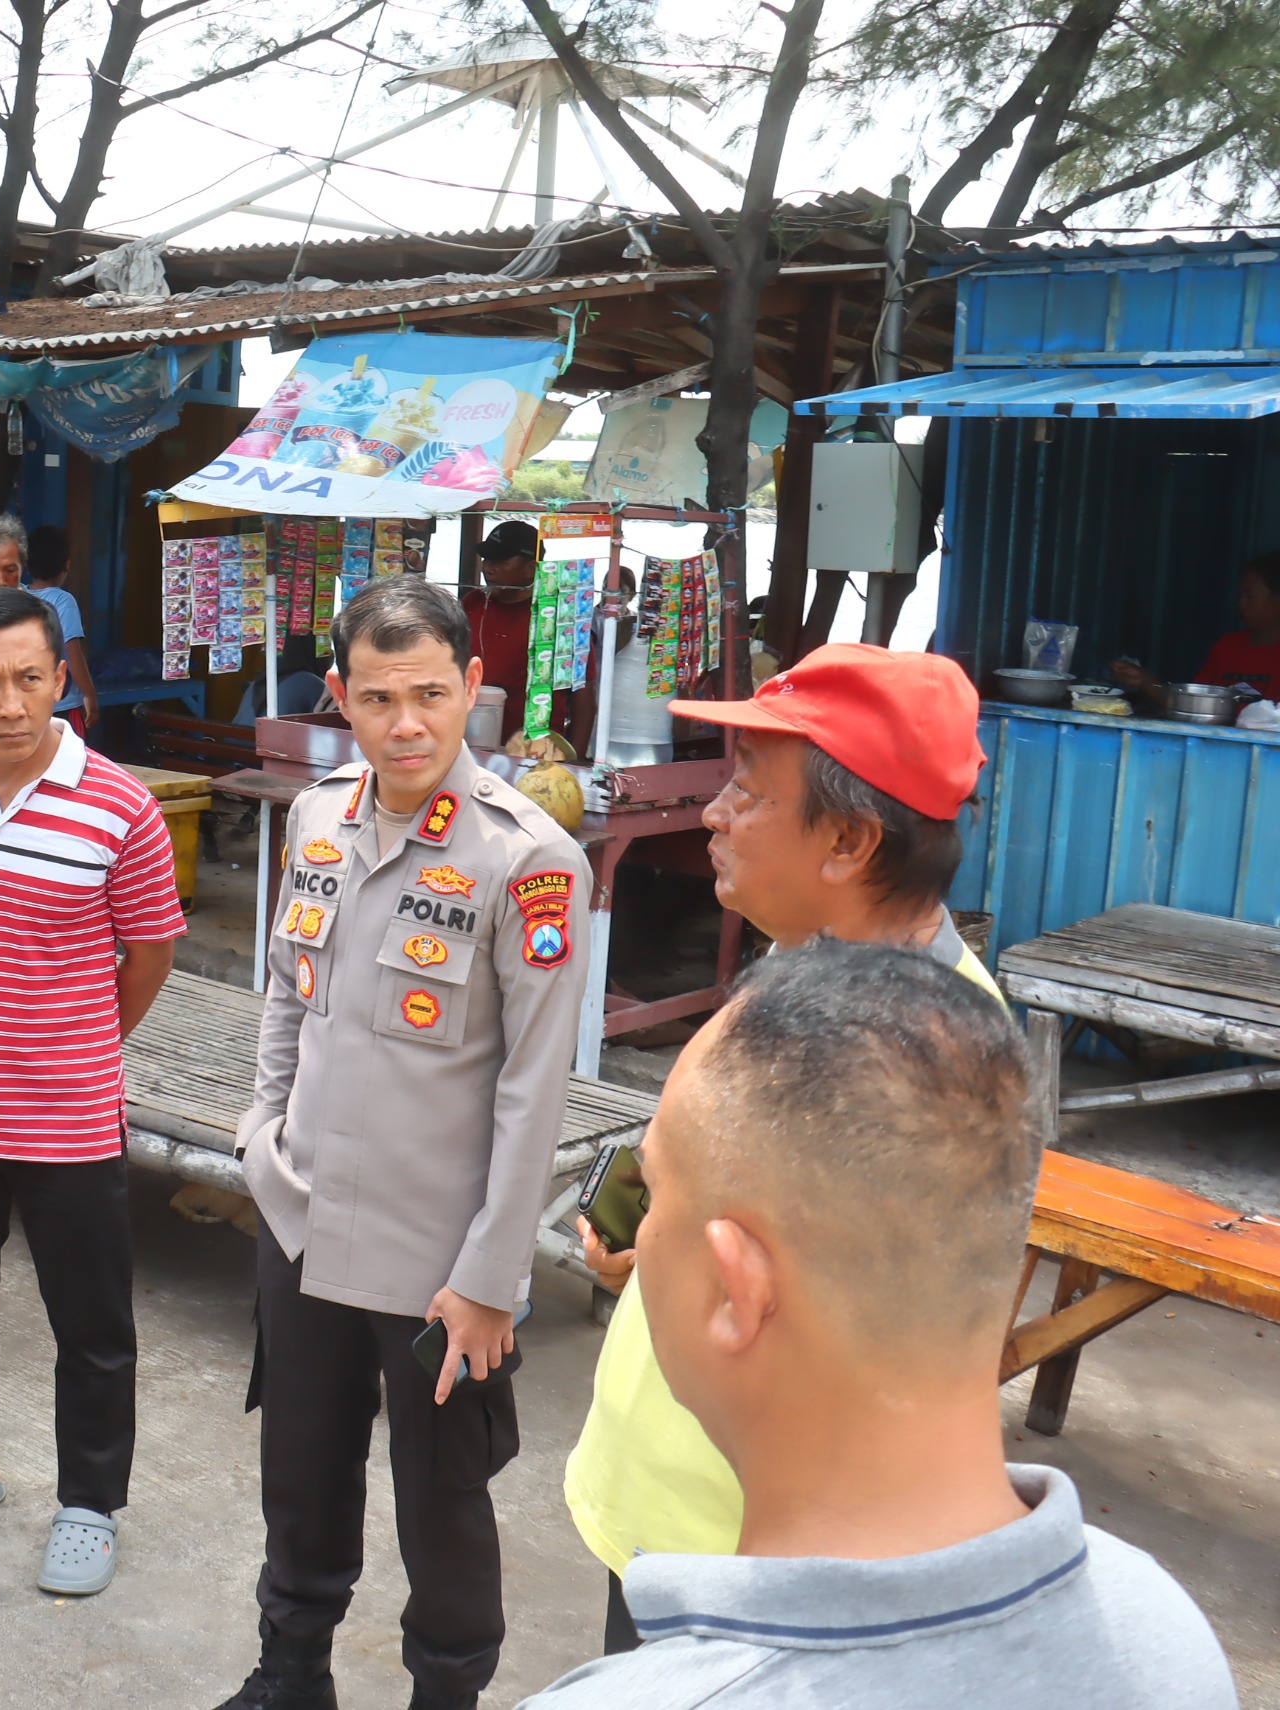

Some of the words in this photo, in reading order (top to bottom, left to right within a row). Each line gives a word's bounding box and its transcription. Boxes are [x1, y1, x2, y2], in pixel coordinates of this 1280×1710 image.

[443, 402, 510, 421] FRESH
[297, 425, 331, 438] POP
[294, 869, 339, 897] RICO
[517, 875, 567, 896] POLRES
[397, 893, 476, 933] POLRI
